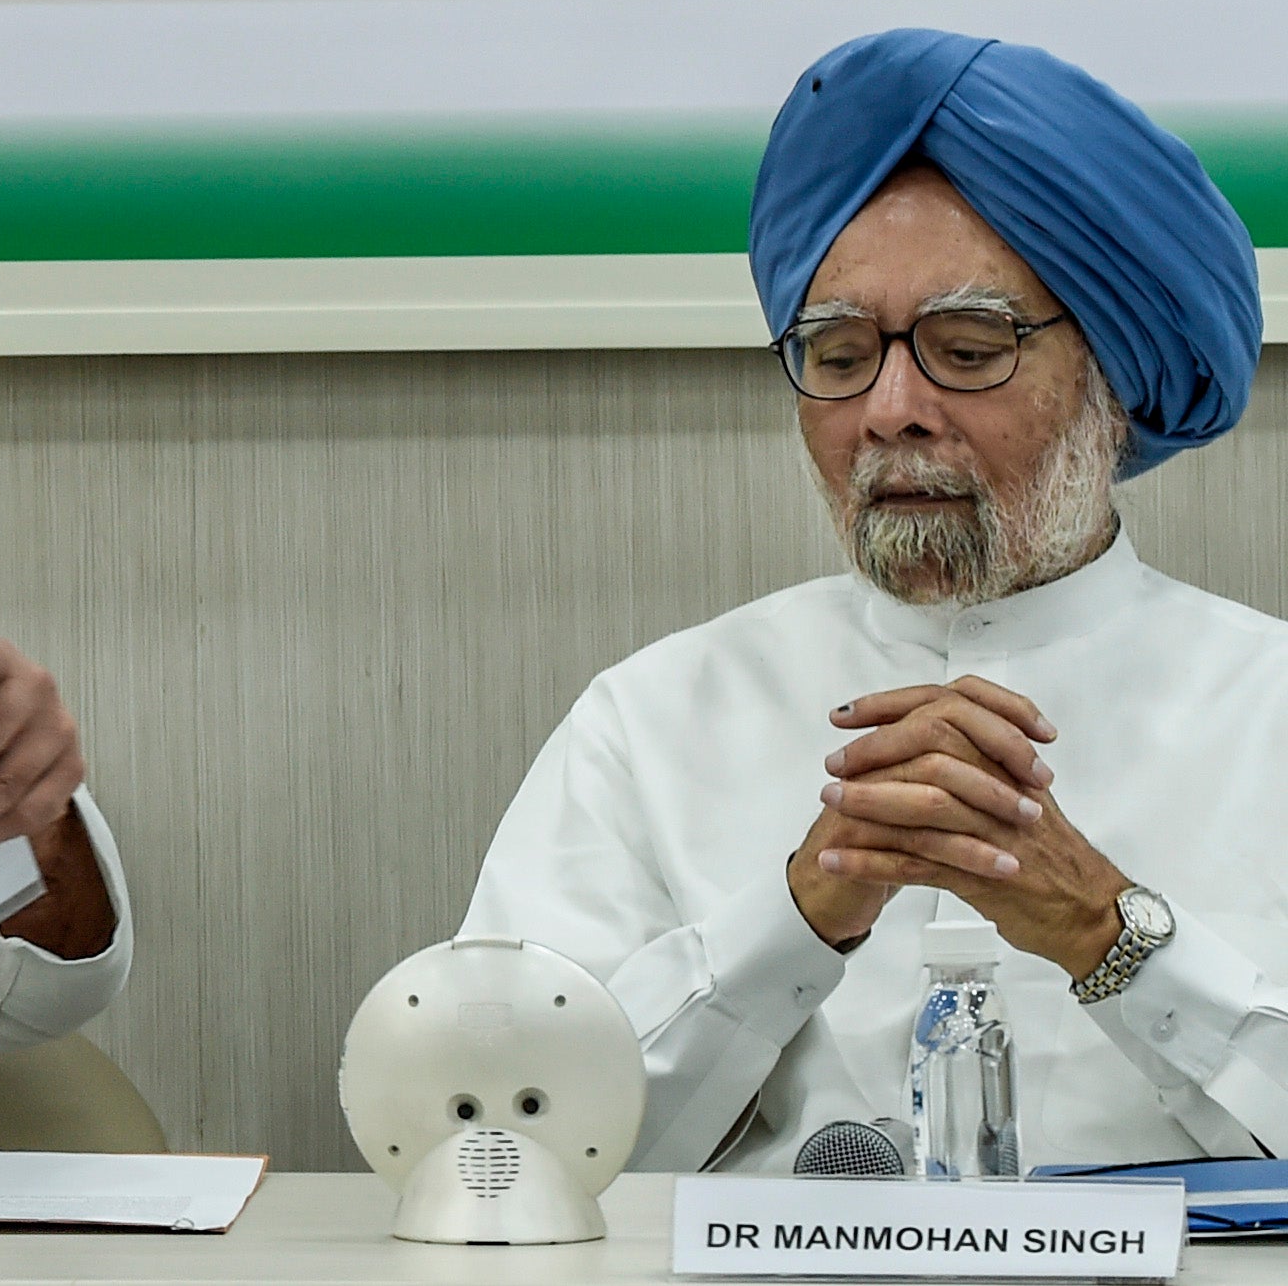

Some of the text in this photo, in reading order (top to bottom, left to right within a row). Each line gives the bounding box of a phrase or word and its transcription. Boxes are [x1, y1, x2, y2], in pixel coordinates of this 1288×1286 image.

[707, 1223, 1145, 1254] DR MANMOHAN SINGH
